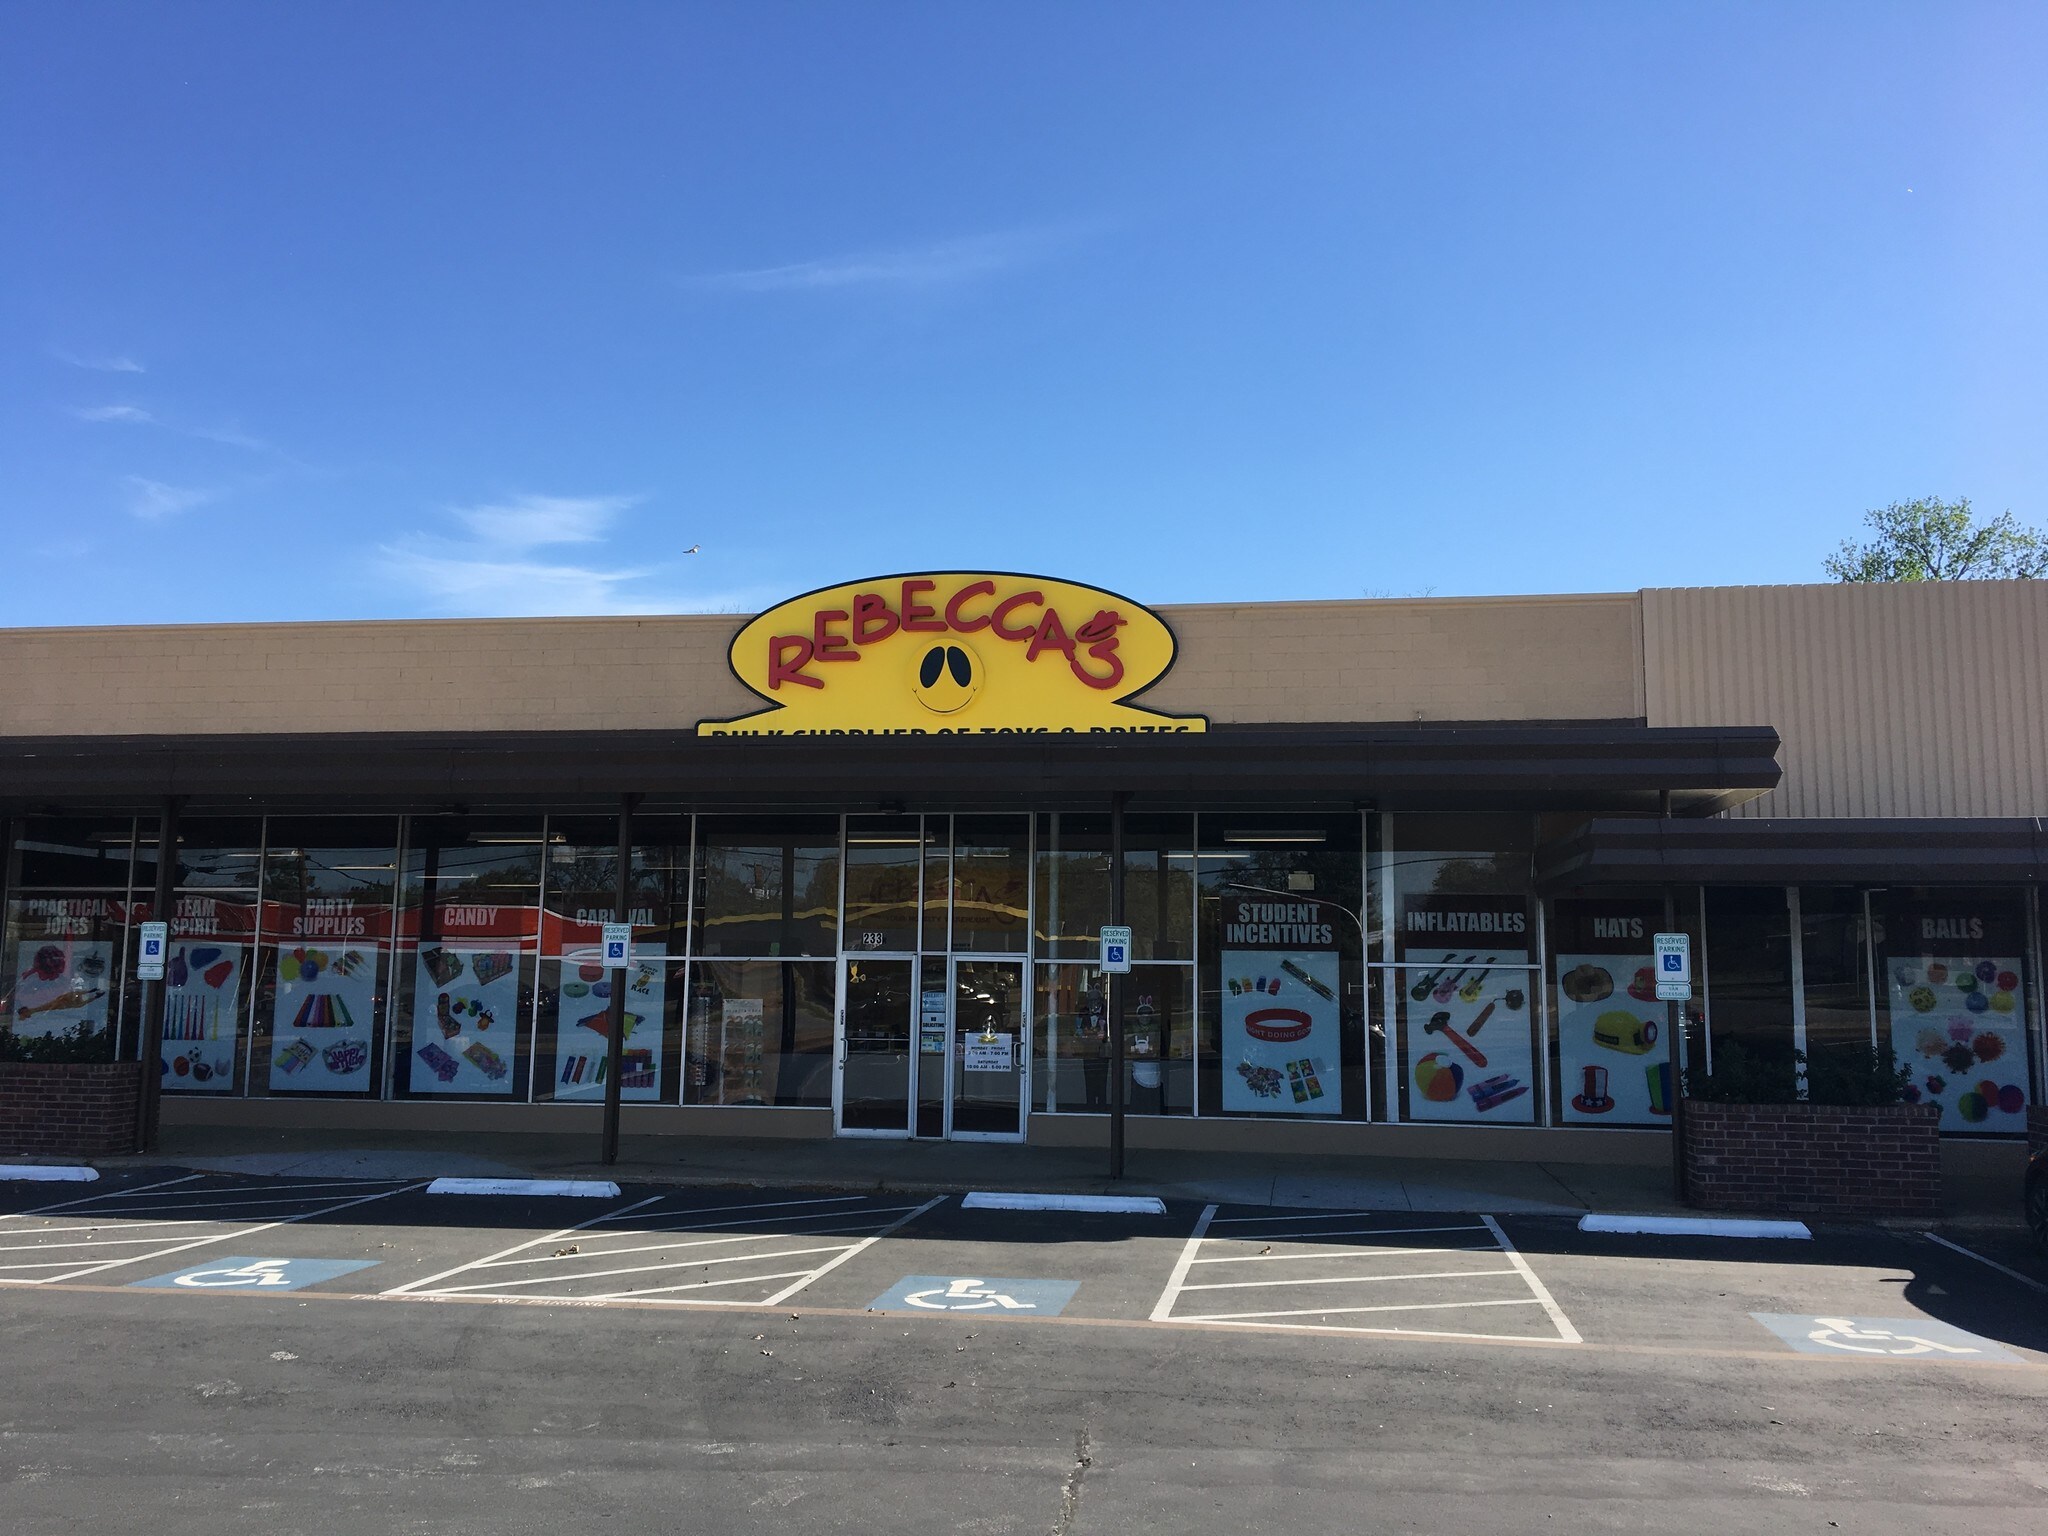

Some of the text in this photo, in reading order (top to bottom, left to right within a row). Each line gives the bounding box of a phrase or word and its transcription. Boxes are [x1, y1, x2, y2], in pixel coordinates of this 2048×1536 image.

[28, 899, 107, 916] PRACTICAL
[177, 899, 215, 917] TEAM
[306, 898, 355, 916] PARTY
[1238, 903, 1320, 923] STUDENT
[45, 916, 88, 935] JOKES
[444, 907, 498, 926] CANDY
[576, 908, 655, 927] CARNVAL
[1407, 911, 1526, 933] INFLATABLES
[170, 917, 219, 935] SPIRIT
[293, 917, 365, 935] SUPPLIES
[1226, 923, 1333, 944] INCENTIVES
[1594, 917, 1643, 938] HATS
[1921, 918, 1983, 939] BALLS
[864, 933, 882, 944] 233
[631, 984, 650, 995] RACE
[1267, 1031, 1296, 1039] DOING
